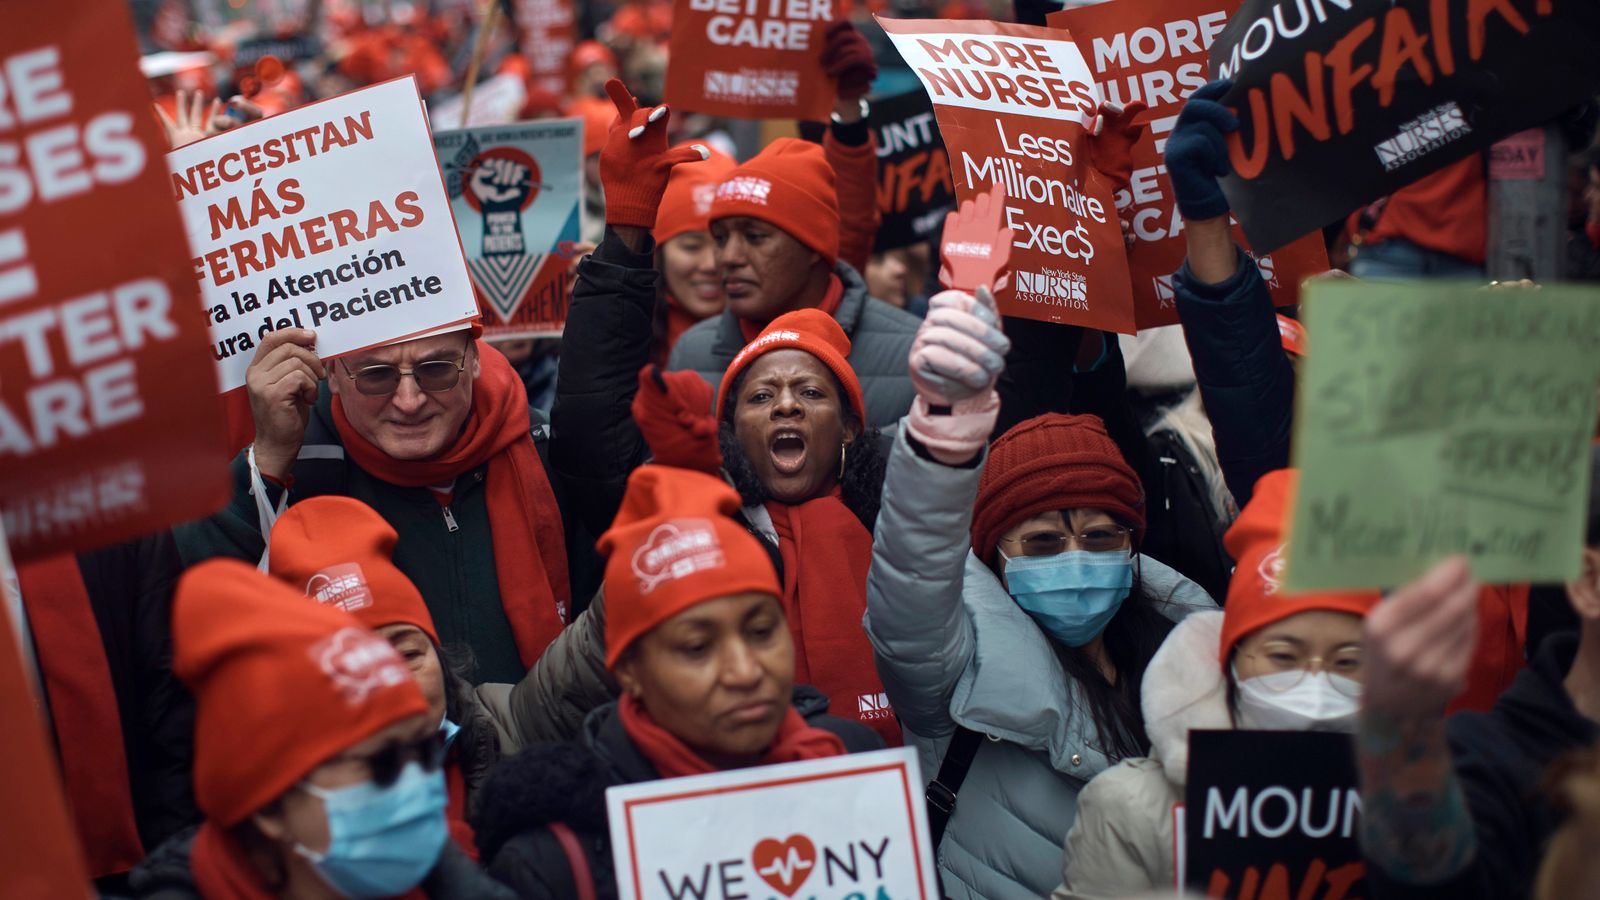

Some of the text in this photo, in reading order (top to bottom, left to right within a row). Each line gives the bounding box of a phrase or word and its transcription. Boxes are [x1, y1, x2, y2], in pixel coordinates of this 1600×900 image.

[705, 15, 812, 50] CARE
[915, 38, 1062, 75] MORE
[1092, 10, 1228, 74] MORE
[917, 66, 1098, 118] NURSES
[1226, 0, 1553, 180] UNFAIR
[171, 110, 374, 201] NECESITAN
[995, 118, 1073, 167] Less
[1373, 106, 1465, 166] NURSES
[1384, 121, 1473, 172] ASSOCIATION
[207, 178, 306, 241] MÁS
[961, 151, 1107, 224] Millionaire
[1005, 206, 1095, 266] Exec$
[231, 290, 262, 316] la
[266, 248, 406, 305] Atención
[306, 274, 443, 328] Paciente
[1015, 291, 1089, 311] ASSOCIATION
[1016, 270, 1087, 302] NURSES
[1041, 266, 1087, 282] New York State
[0, 276, 180, 380] TER
[658, 836, 890, 900] WE NY
